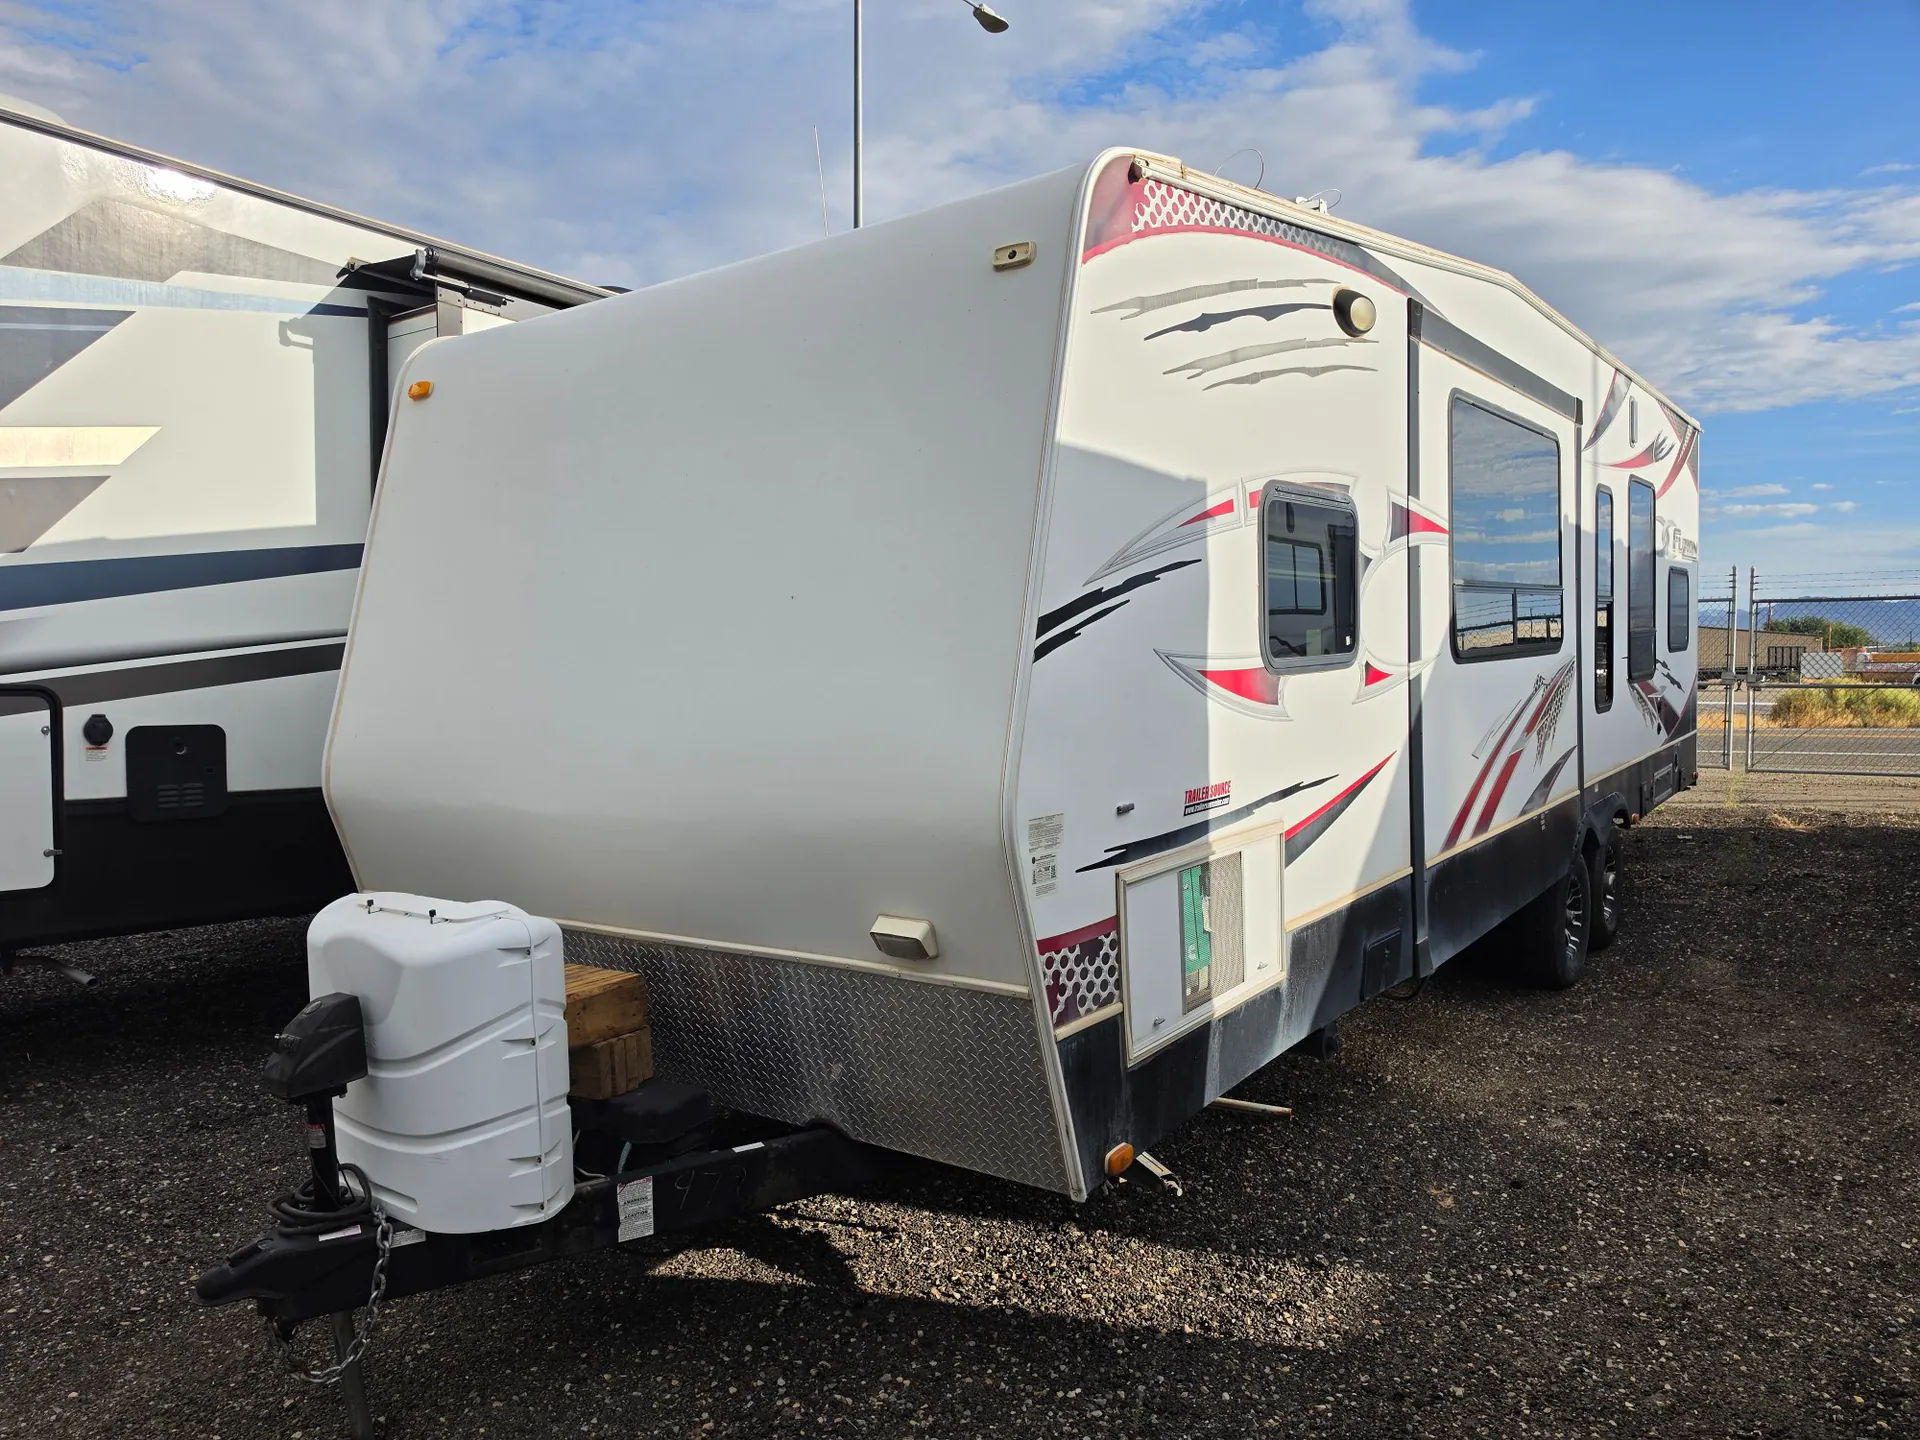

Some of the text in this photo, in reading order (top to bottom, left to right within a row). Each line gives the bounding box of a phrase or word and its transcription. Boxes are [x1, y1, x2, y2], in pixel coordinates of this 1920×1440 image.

[1185, 780, 1231, 804] TRAILER SOURCE
[627, 1210, 648, 1218] CAUTION
